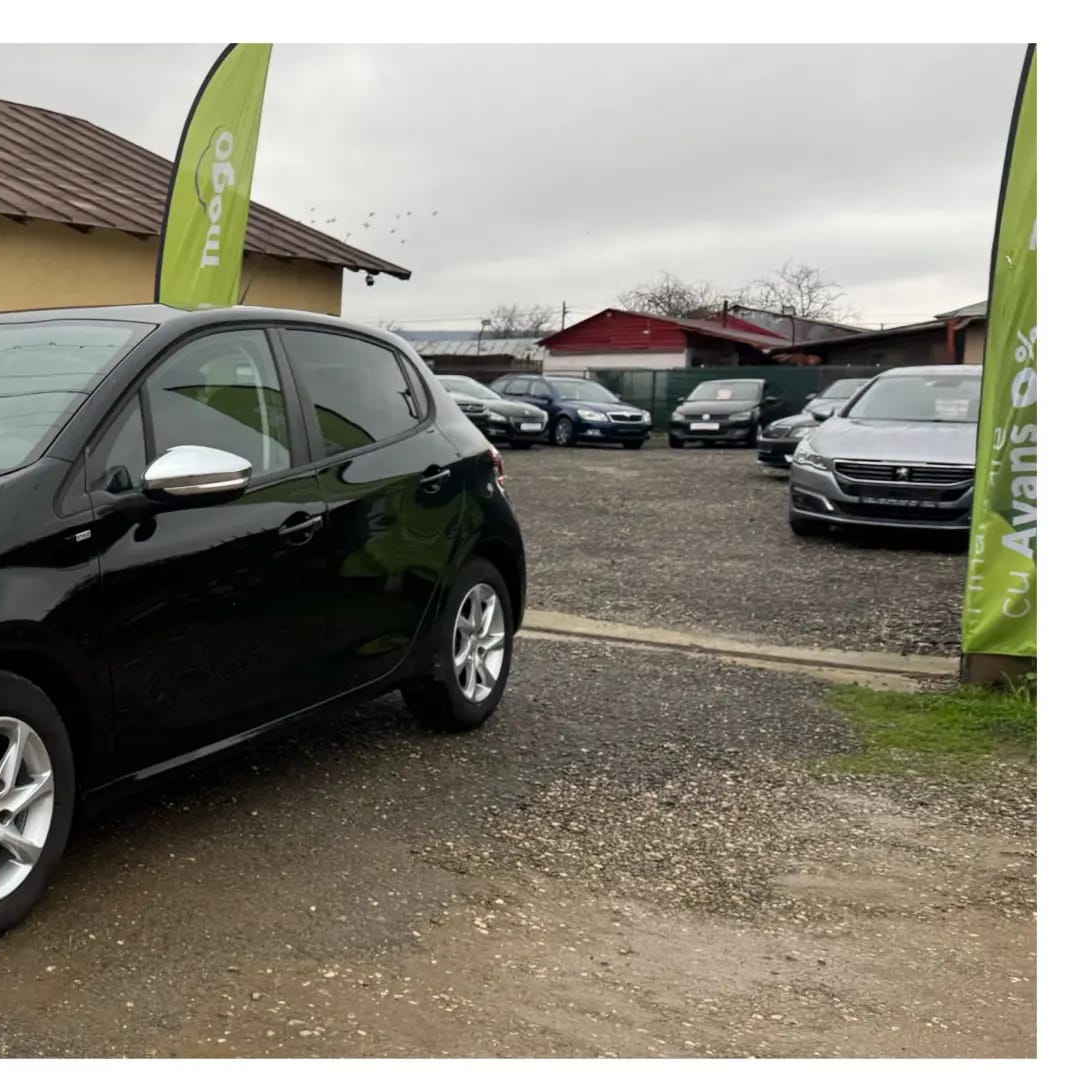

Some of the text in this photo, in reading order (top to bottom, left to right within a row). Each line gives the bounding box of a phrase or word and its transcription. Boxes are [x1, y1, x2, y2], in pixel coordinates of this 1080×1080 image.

[200, 131, 235, 268] mogo
[1002, 424, 1037, 561] Avans
[1002, 570, 1032, 618] cu
